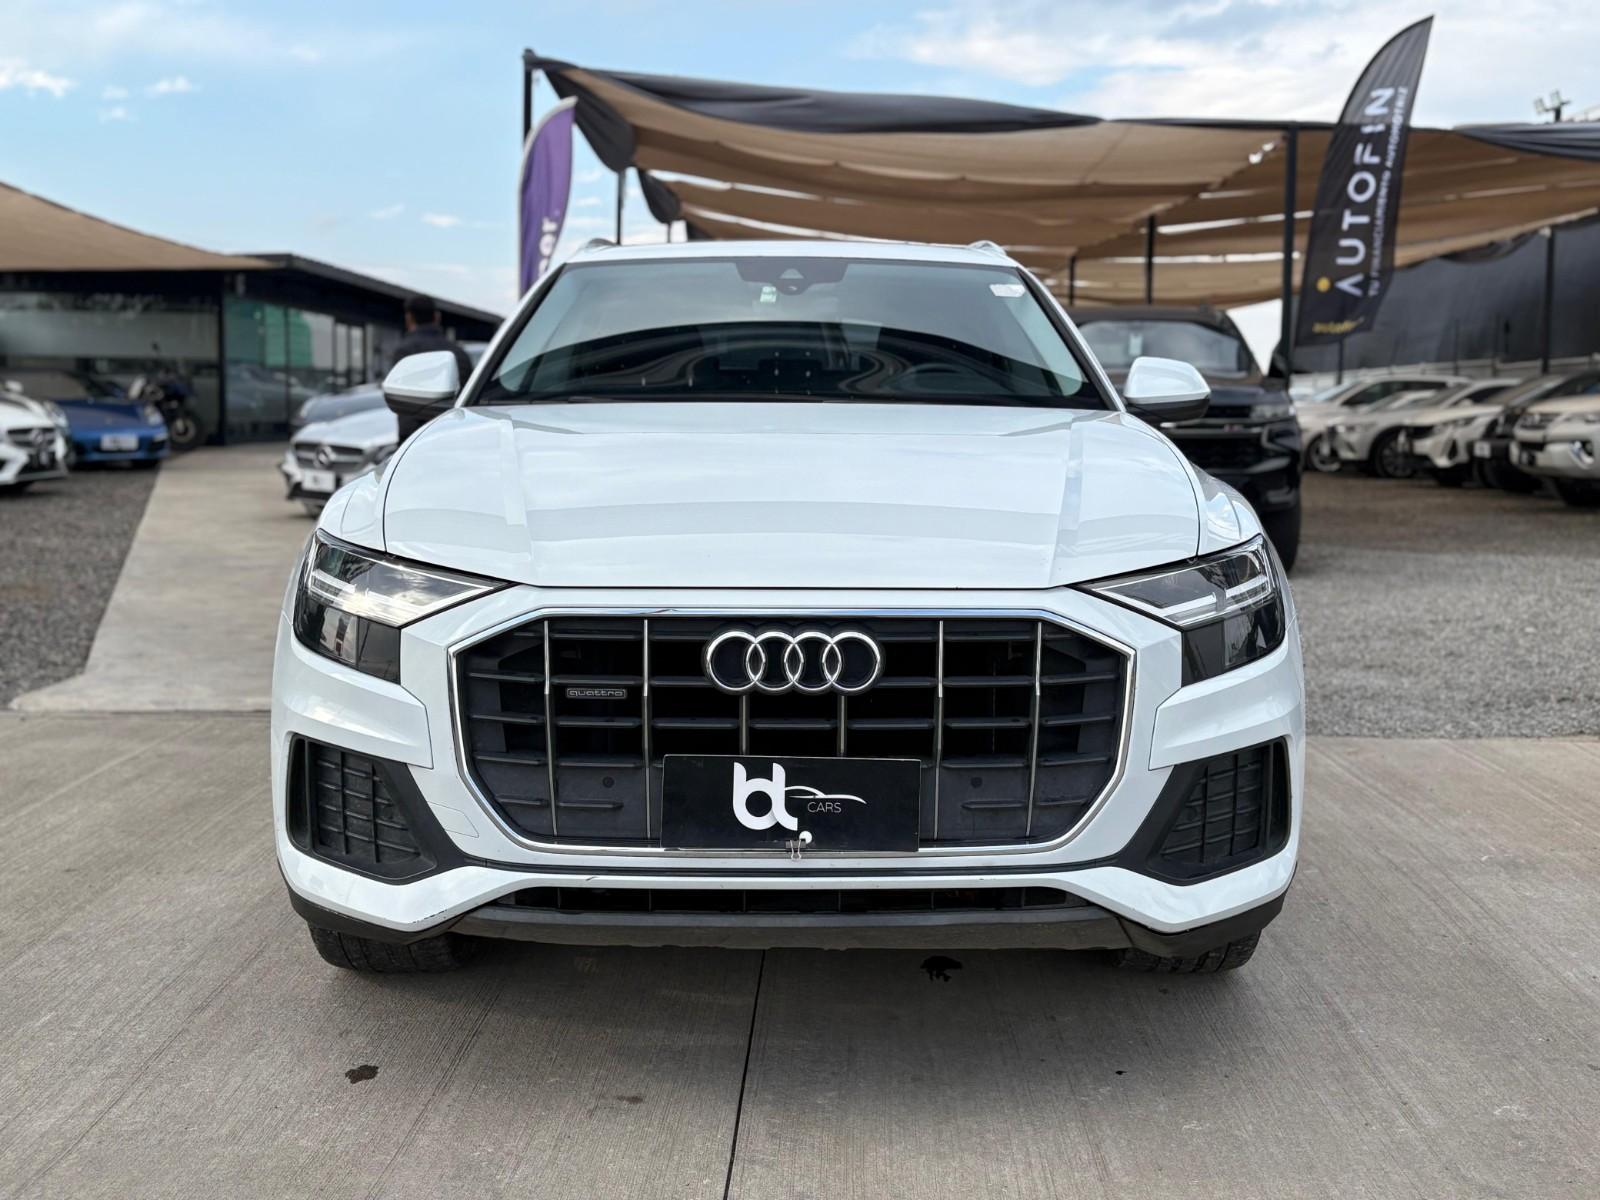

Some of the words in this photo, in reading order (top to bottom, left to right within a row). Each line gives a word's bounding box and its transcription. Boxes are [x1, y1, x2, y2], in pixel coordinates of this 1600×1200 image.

[1335, 87, 1394, 297] AUTOFIN
[568, 689, 624, 698] quattro
[807, 801, 842, 813] CARS
